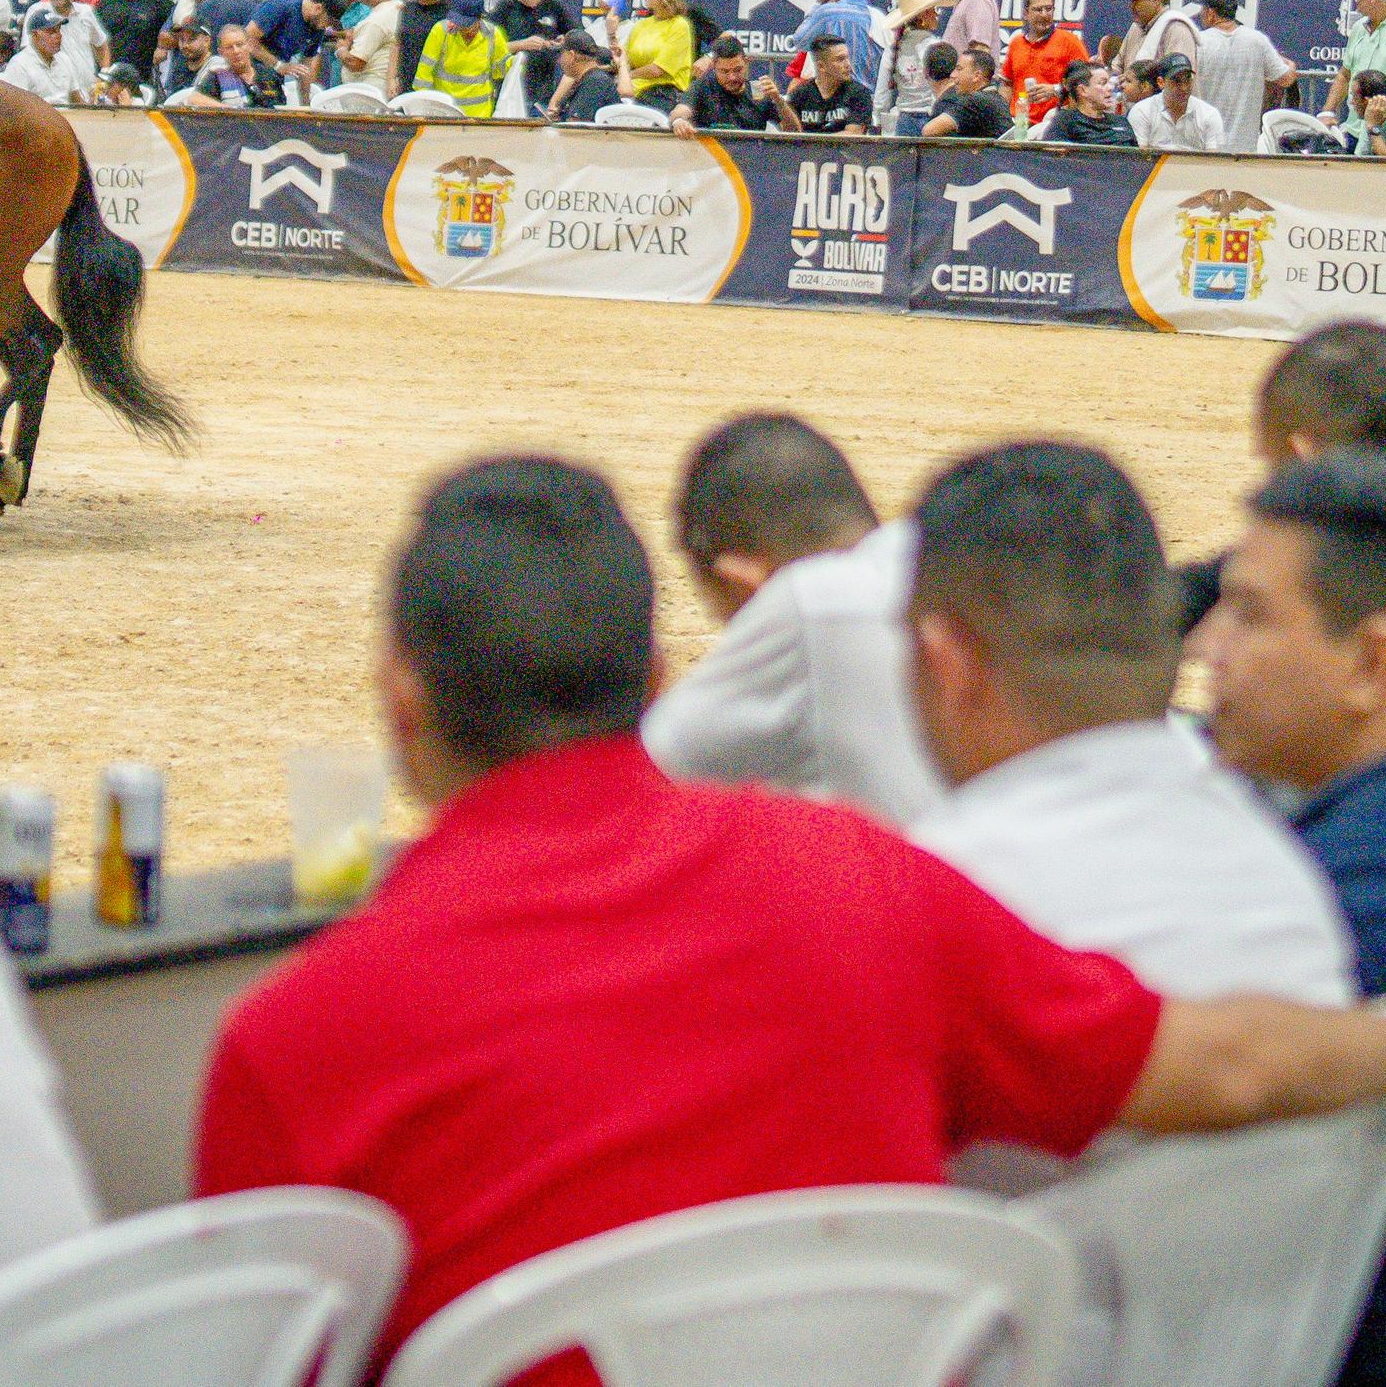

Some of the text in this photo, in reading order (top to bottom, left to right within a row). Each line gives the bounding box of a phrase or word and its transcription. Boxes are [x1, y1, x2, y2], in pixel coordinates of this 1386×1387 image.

[730, 31, 765, 53] EB
[524, 189, 693, 217] GOBERNACIÓN
[792, 161, 891, 233] AGRO
[230, 221, 344, 250] CEB NORTE
[521, 217, 690, 256] DE BOLÍVAR
[823, 234, 886, 272] BOLÍVAR
[794, 274, 875, 289] 2024 Zona Norte
[931, 263, 1074, 295] CEB NORTE
[1286, 266, 1309, 283] DE
